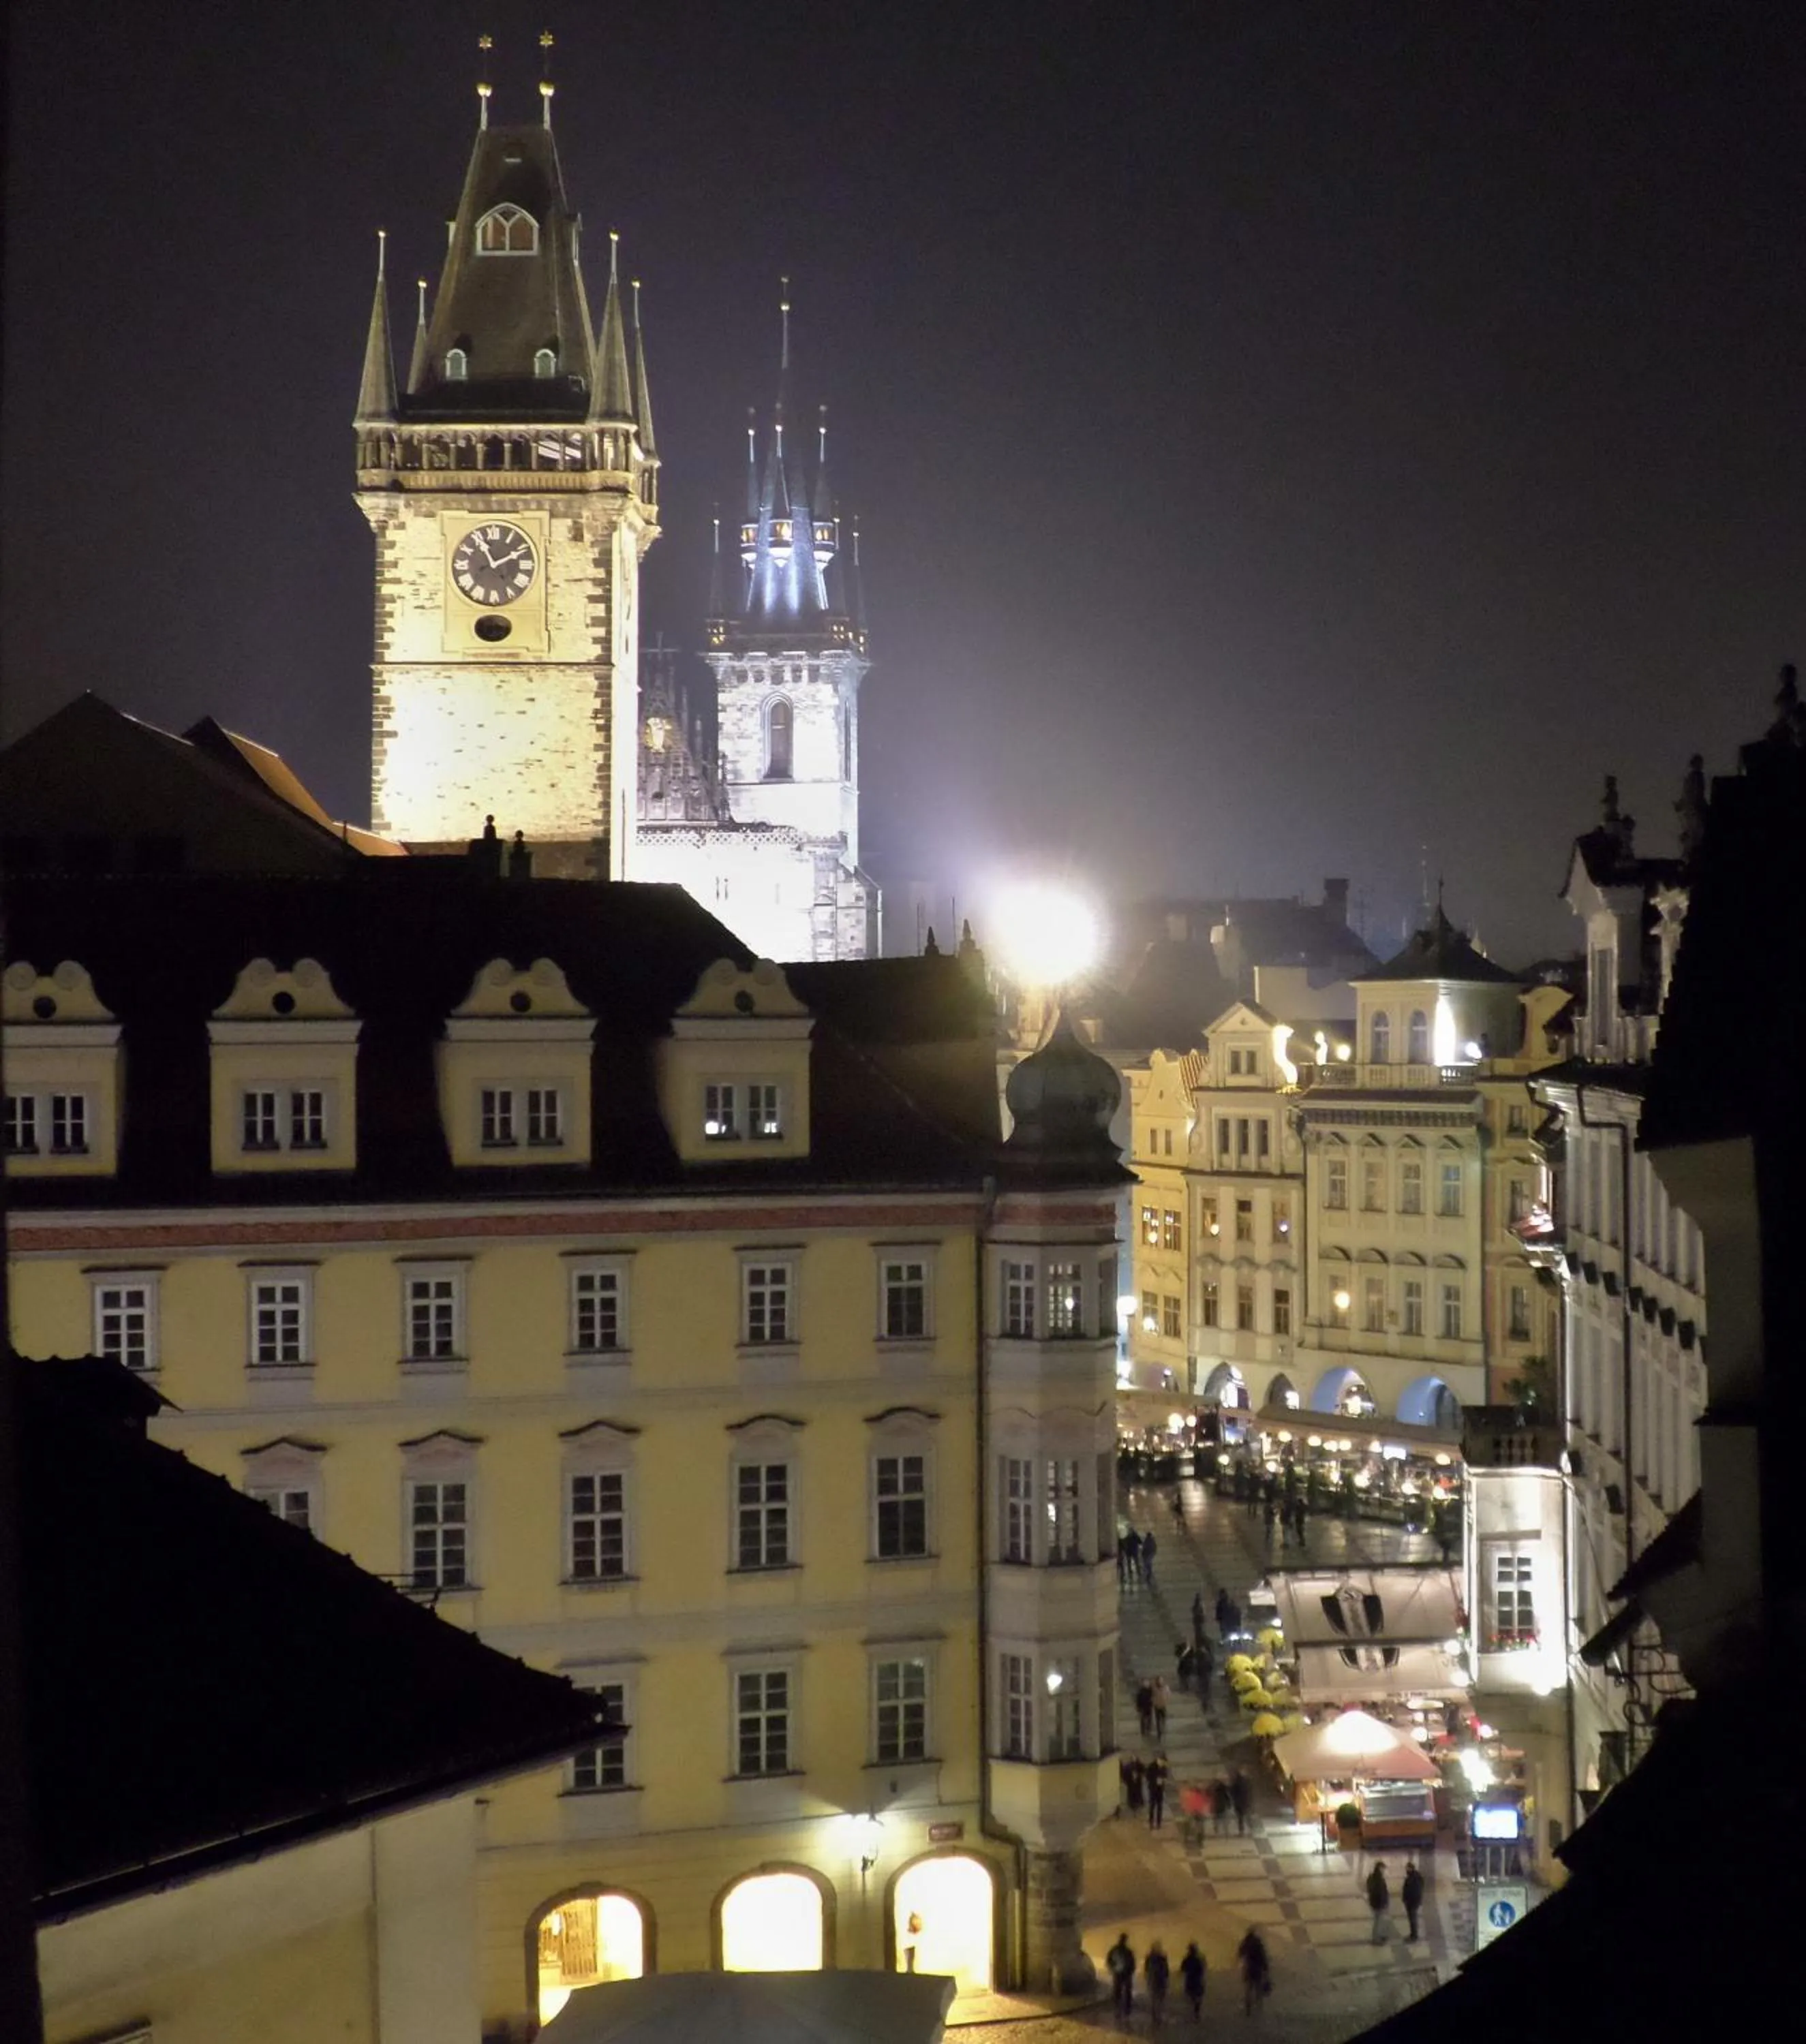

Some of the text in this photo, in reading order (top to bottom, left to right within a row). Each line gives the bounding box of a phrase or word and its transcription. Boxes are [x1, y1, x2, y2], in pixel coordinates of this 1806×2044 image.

[486, 527, 500, 540] XII
[459, 544, 474, 556] X
[506, 586, 515, 599] V
